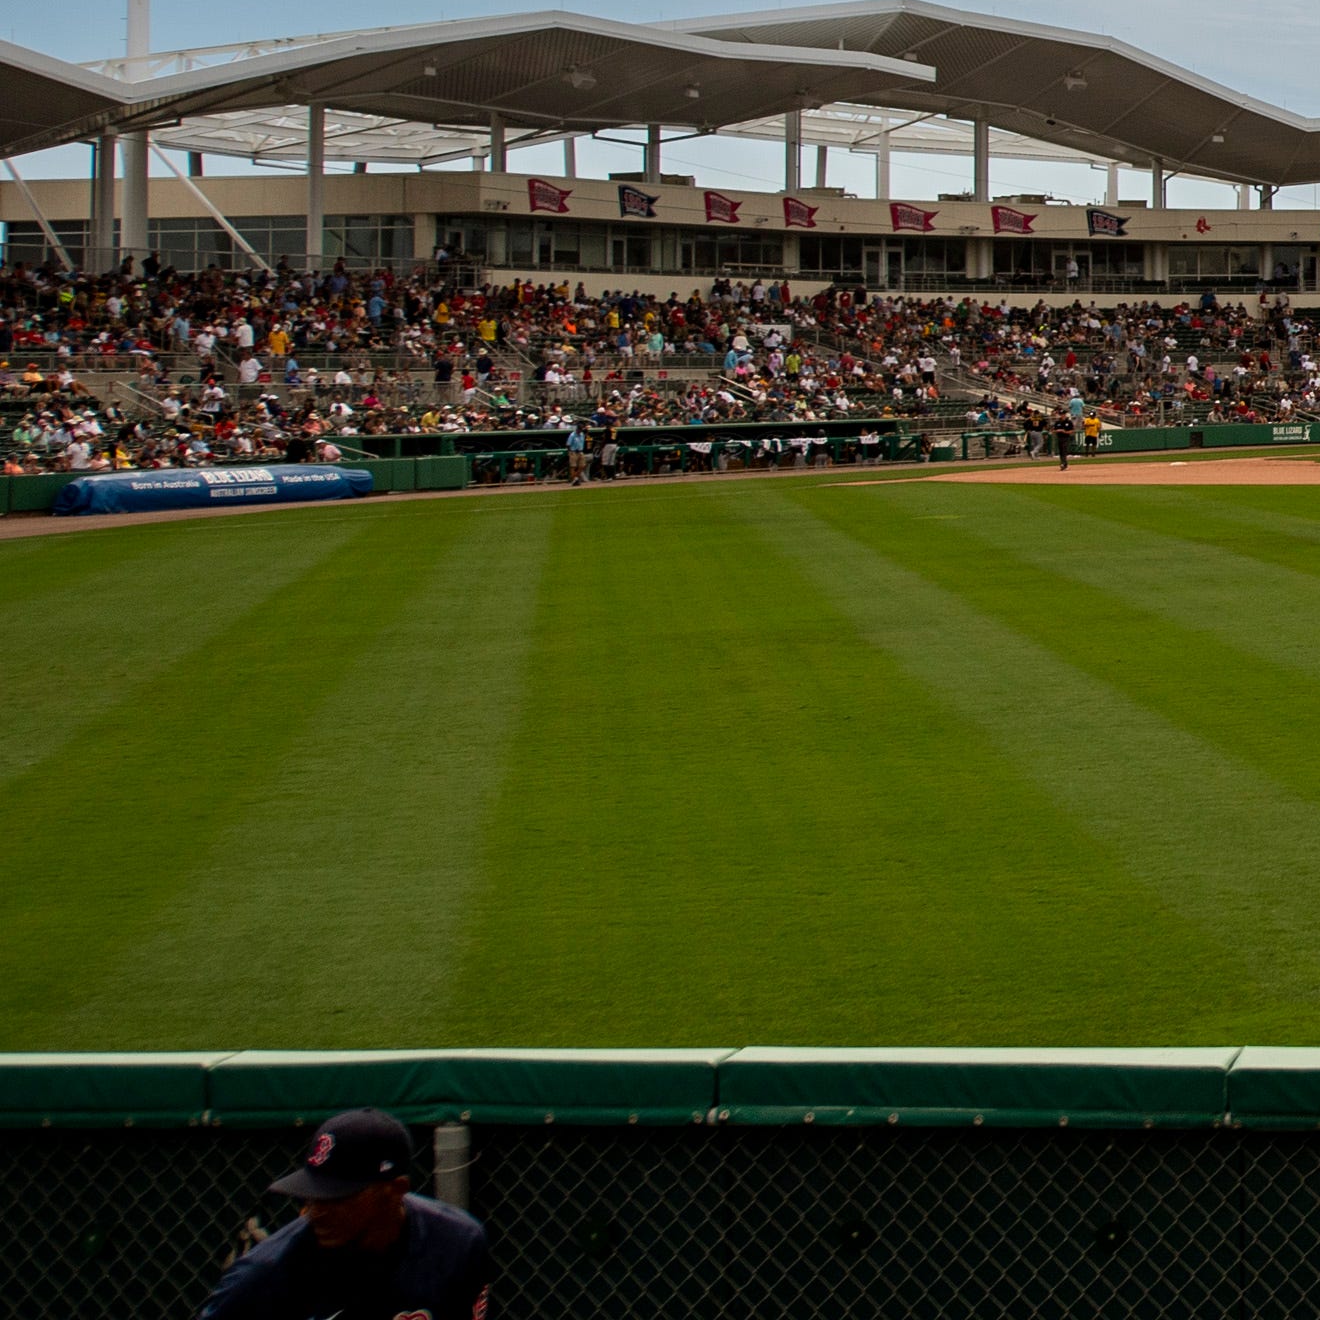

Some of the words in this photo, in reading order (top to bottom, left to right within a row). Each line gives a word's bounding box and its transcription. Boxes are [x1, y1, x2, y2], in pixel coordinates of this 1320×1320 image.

[1273, 426, 1285, 435] BLUE
[1285, 426, 1302, 434] LIZARD
[200, 471, 235, 484] BLUE
[230, 469, 274, 482] LIZARD
[325, 473, 341, 481] USA
[131, 481, 152, 490] Born
[163, 479, 200, 488] Australia
